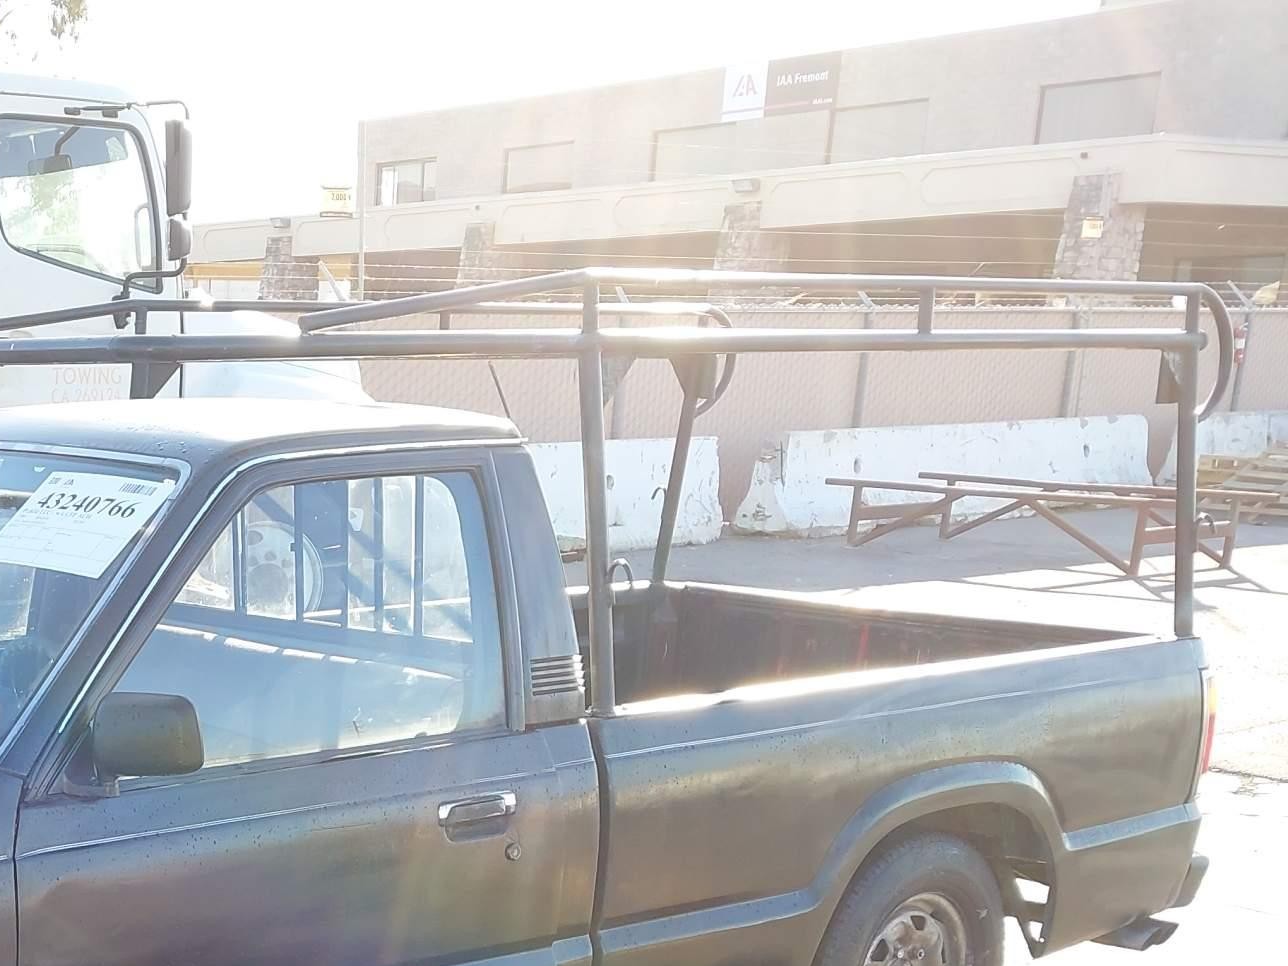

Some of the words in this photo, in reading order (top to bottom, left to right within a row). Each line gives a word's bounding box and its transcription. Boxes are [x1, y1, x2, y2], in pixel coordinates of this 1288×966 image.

[776, 74, 793, 87] IAA
[794, 70, 829, 84] Fremont
[52, 367, 122, 385] TOWING
[37, 492, 143, 519] 43240766
